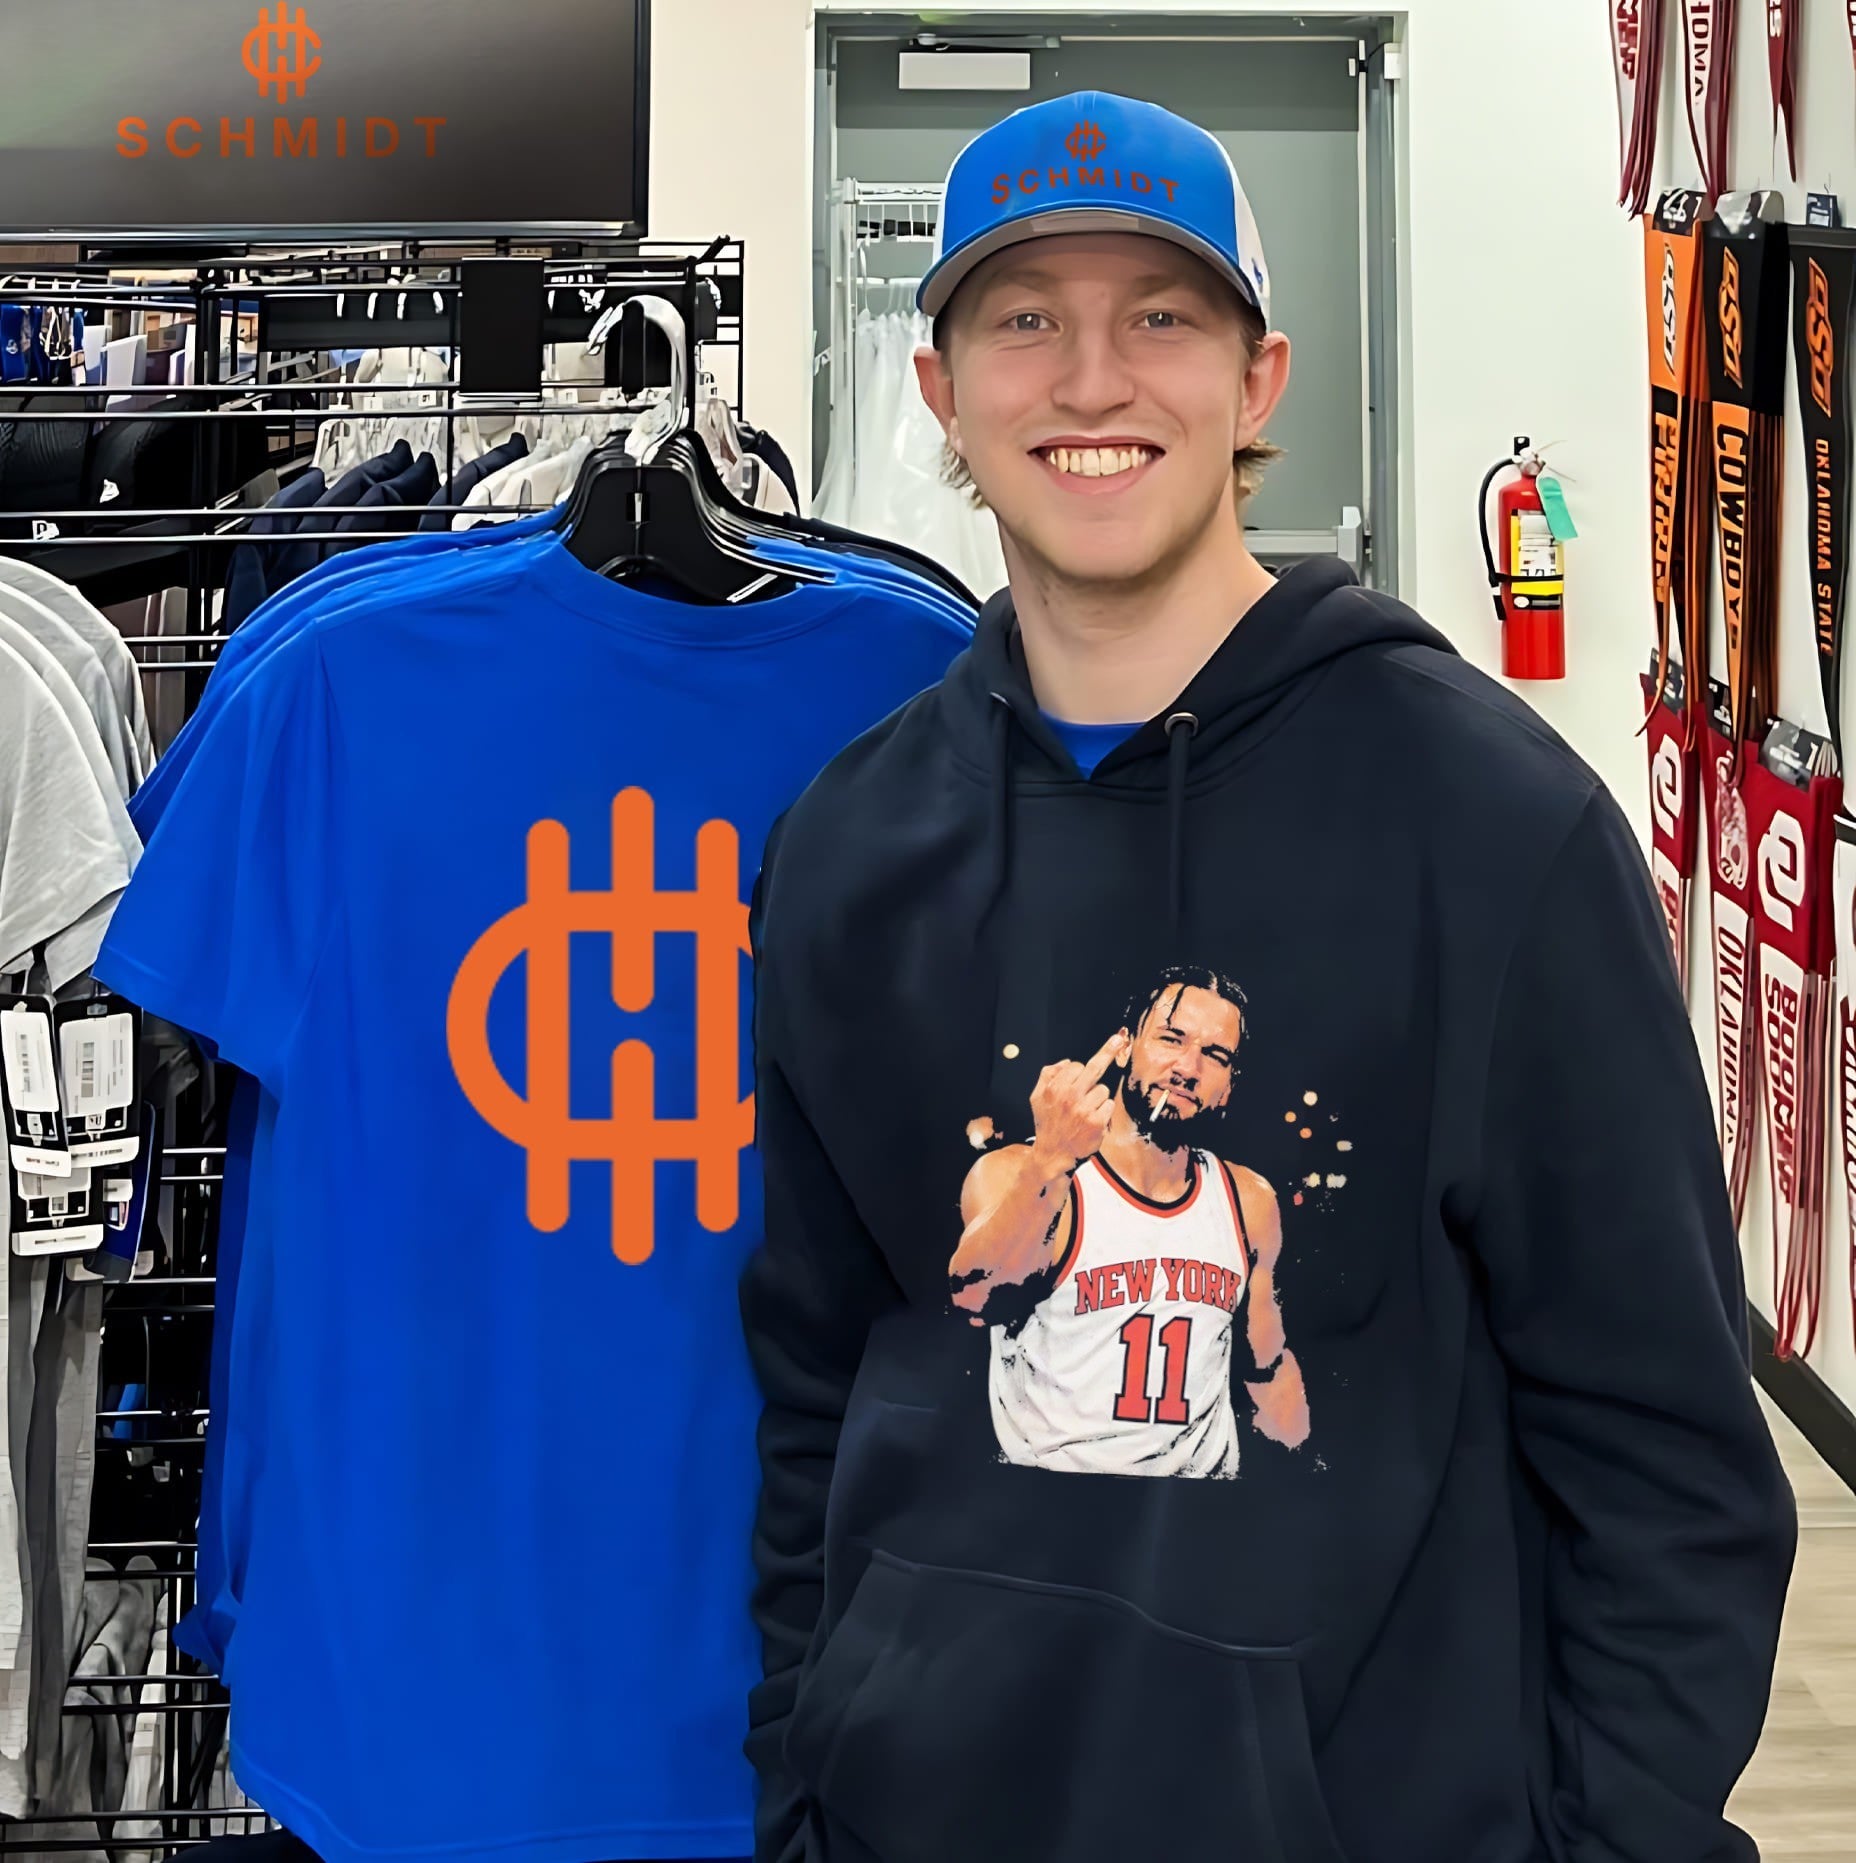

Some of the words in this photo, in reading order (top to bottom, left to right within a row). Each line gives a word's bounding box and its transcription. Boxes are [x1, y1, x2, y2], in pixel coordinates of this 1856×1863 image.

[116, 117, 448, 159] SCHMIDT
[991, 167, 1180, 205] SCHMIDT
[1805, 257, 1834, 418] OSU
[1815, 439, 1832, 571] OKLAHOMA
[1718, 926, 1745, 1144] OKLAHOMA
[1073, 1259, 1157, 1315] NEW
[1160, 1257, 1242, 1315] YORK
[1113, 1313, 1193, 1426] 11
